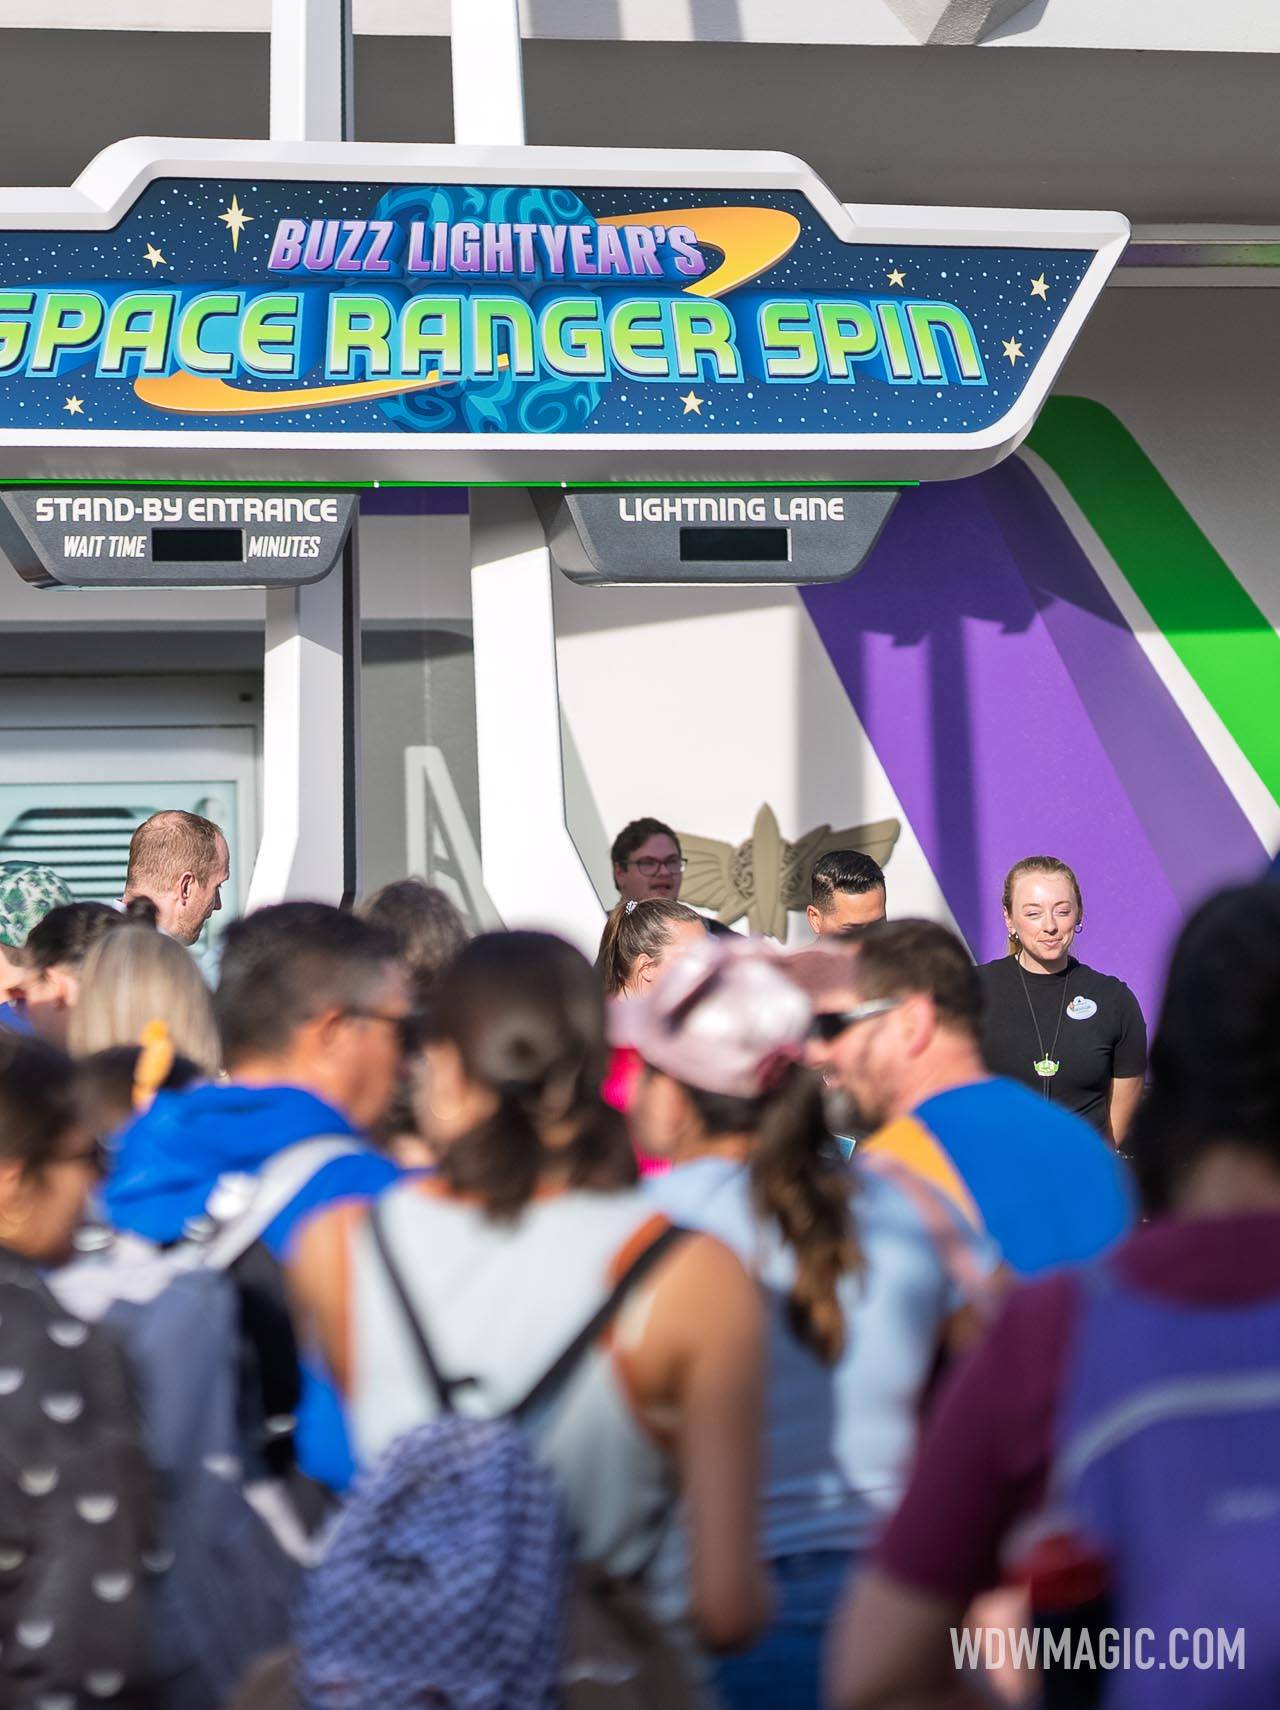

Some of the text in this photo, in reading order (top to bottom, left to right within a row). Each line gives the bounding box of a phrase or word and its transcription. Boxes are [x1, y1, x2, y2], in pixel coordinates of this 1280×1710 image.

[268, 219, 707, 276] BUZZ LIGHTYEAR'S
[325, 292, 744, 384] RANGER
[757, 300, 988, 386] SPIN
[35, 497, 338, 523] STAND-BY ENTRANCE
[619, 497, 845, 522] LIGHTNING LANE
[63, 535, 321, 558] WAIT TIME MINUTES
